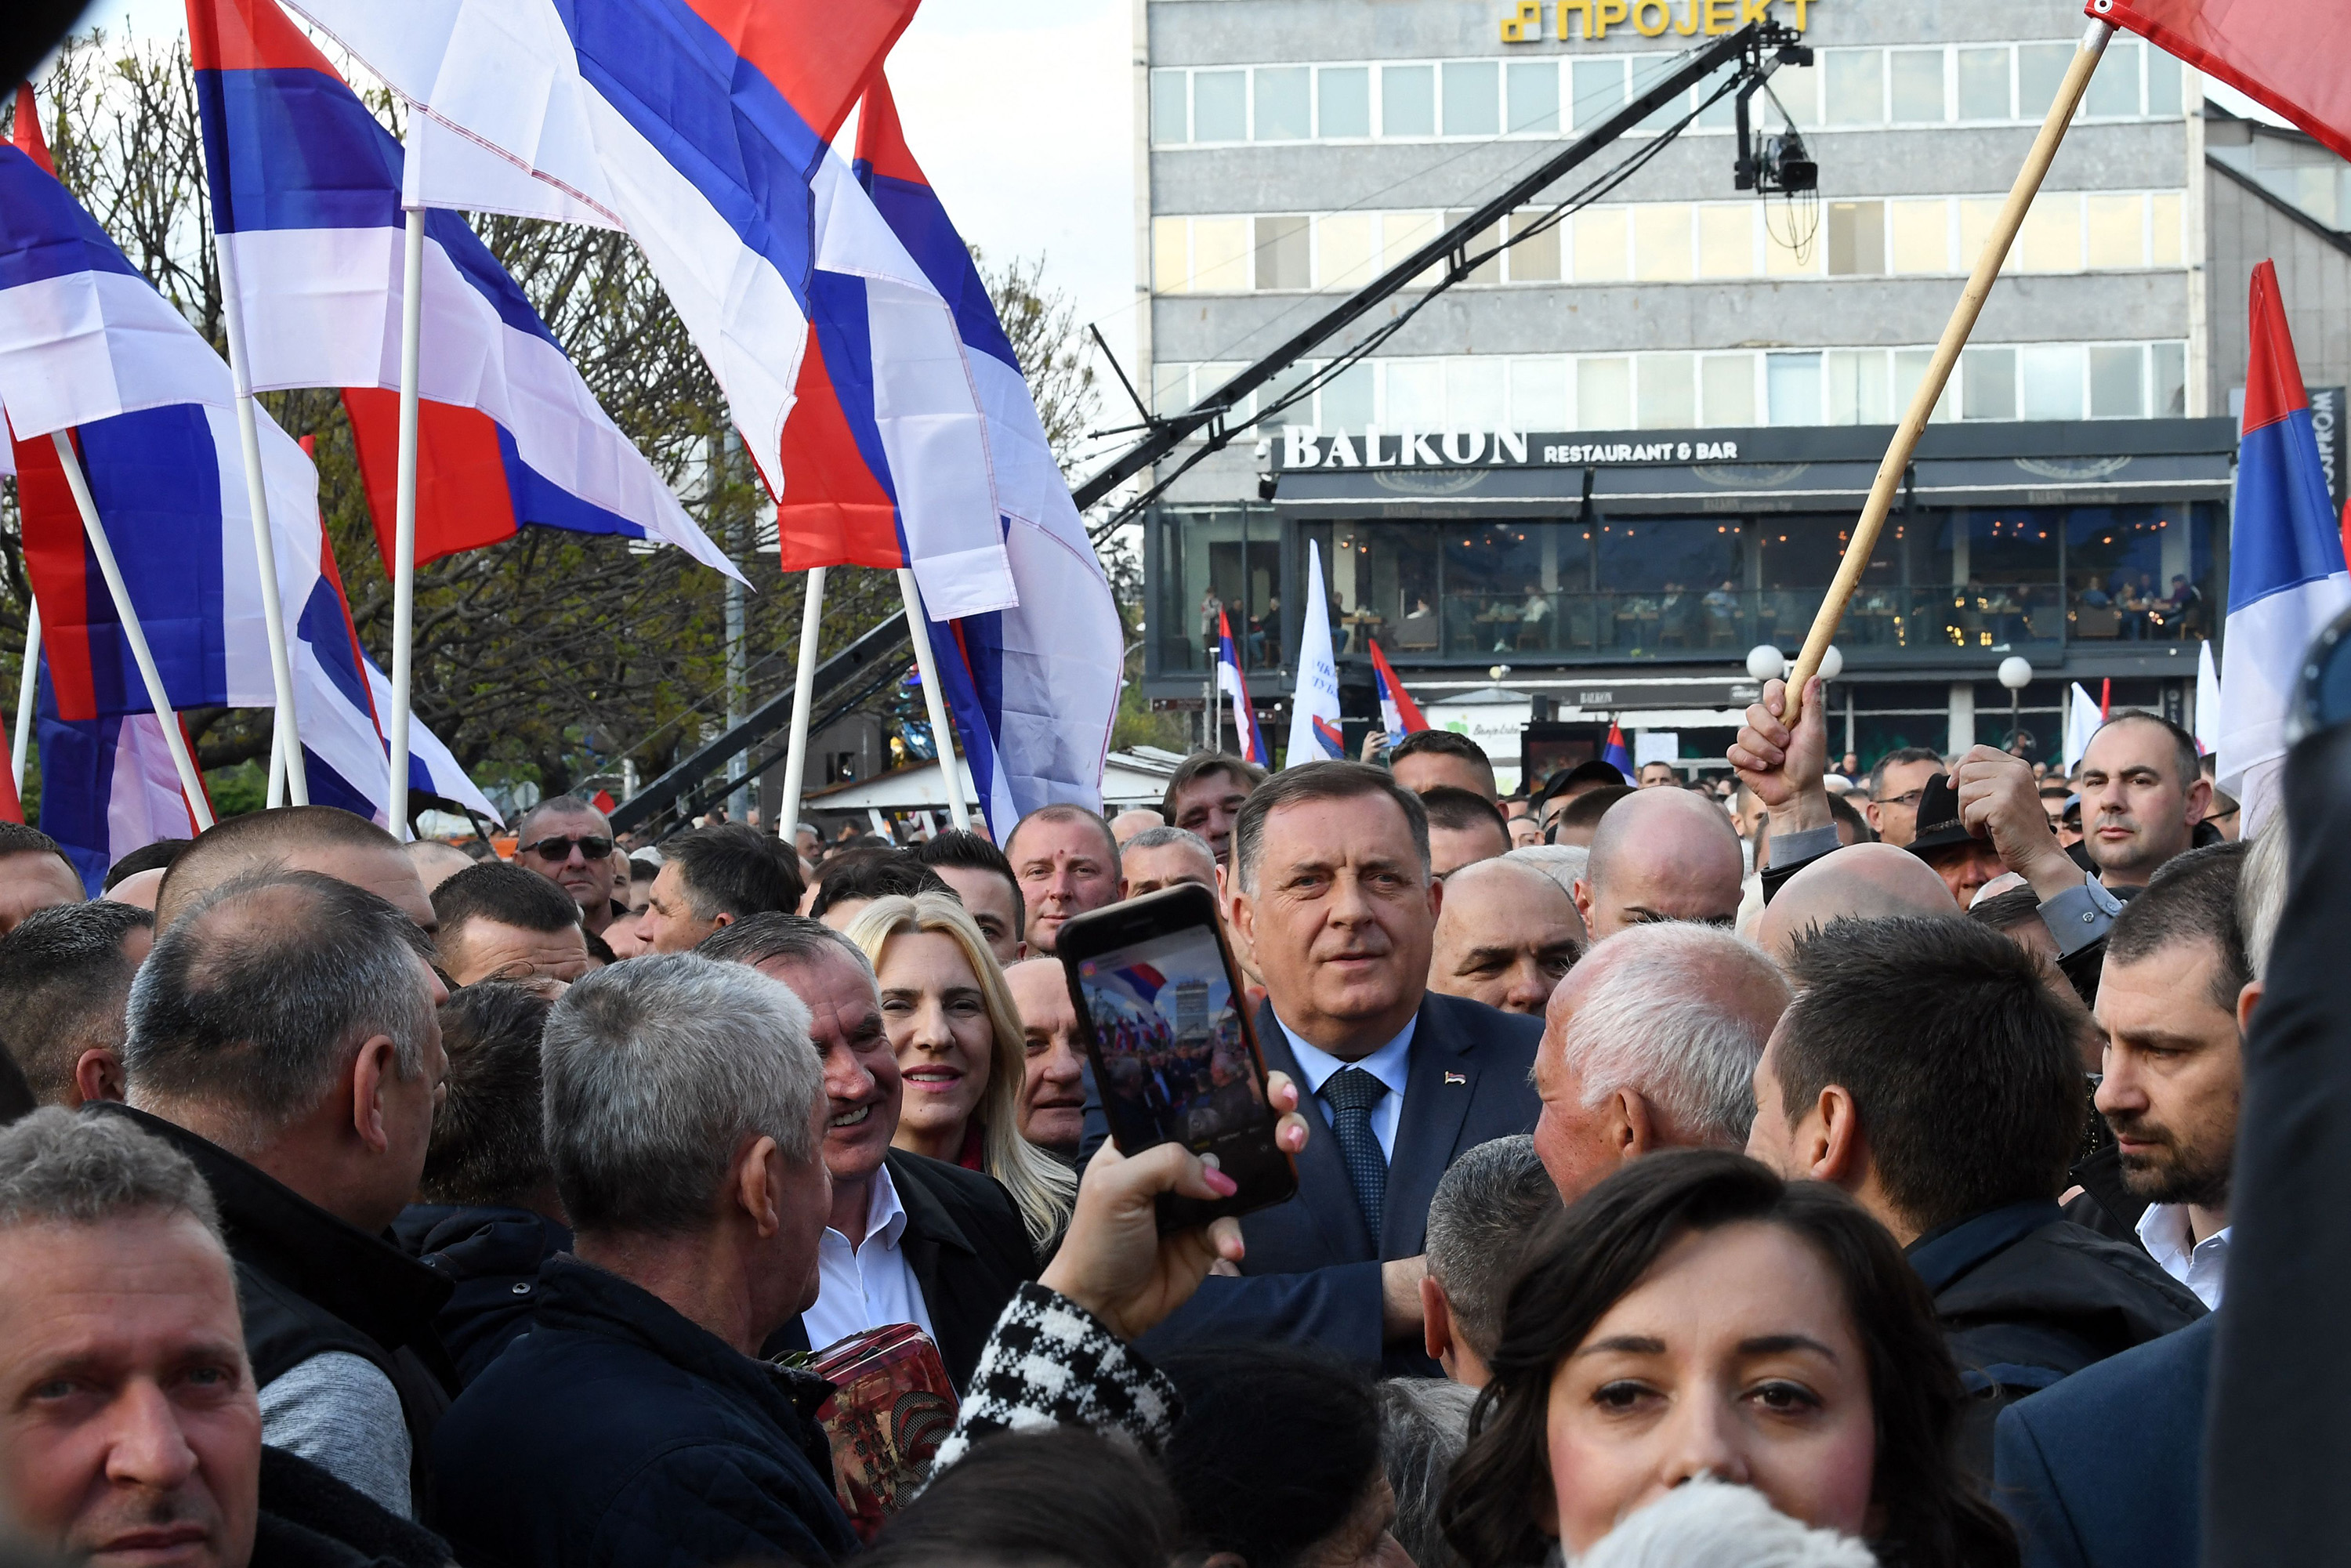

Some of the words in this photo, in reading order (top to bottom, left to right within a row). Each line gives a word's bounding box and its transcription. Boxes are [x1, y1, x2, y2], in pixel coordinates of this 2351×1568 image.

[1281, 422, 1529, 469] BALKON
[1543, 442, 1674, 464] RESTAURANT
[1676, 443, 1693, 462] &
[1696, 441, 1738, 461] BAR
